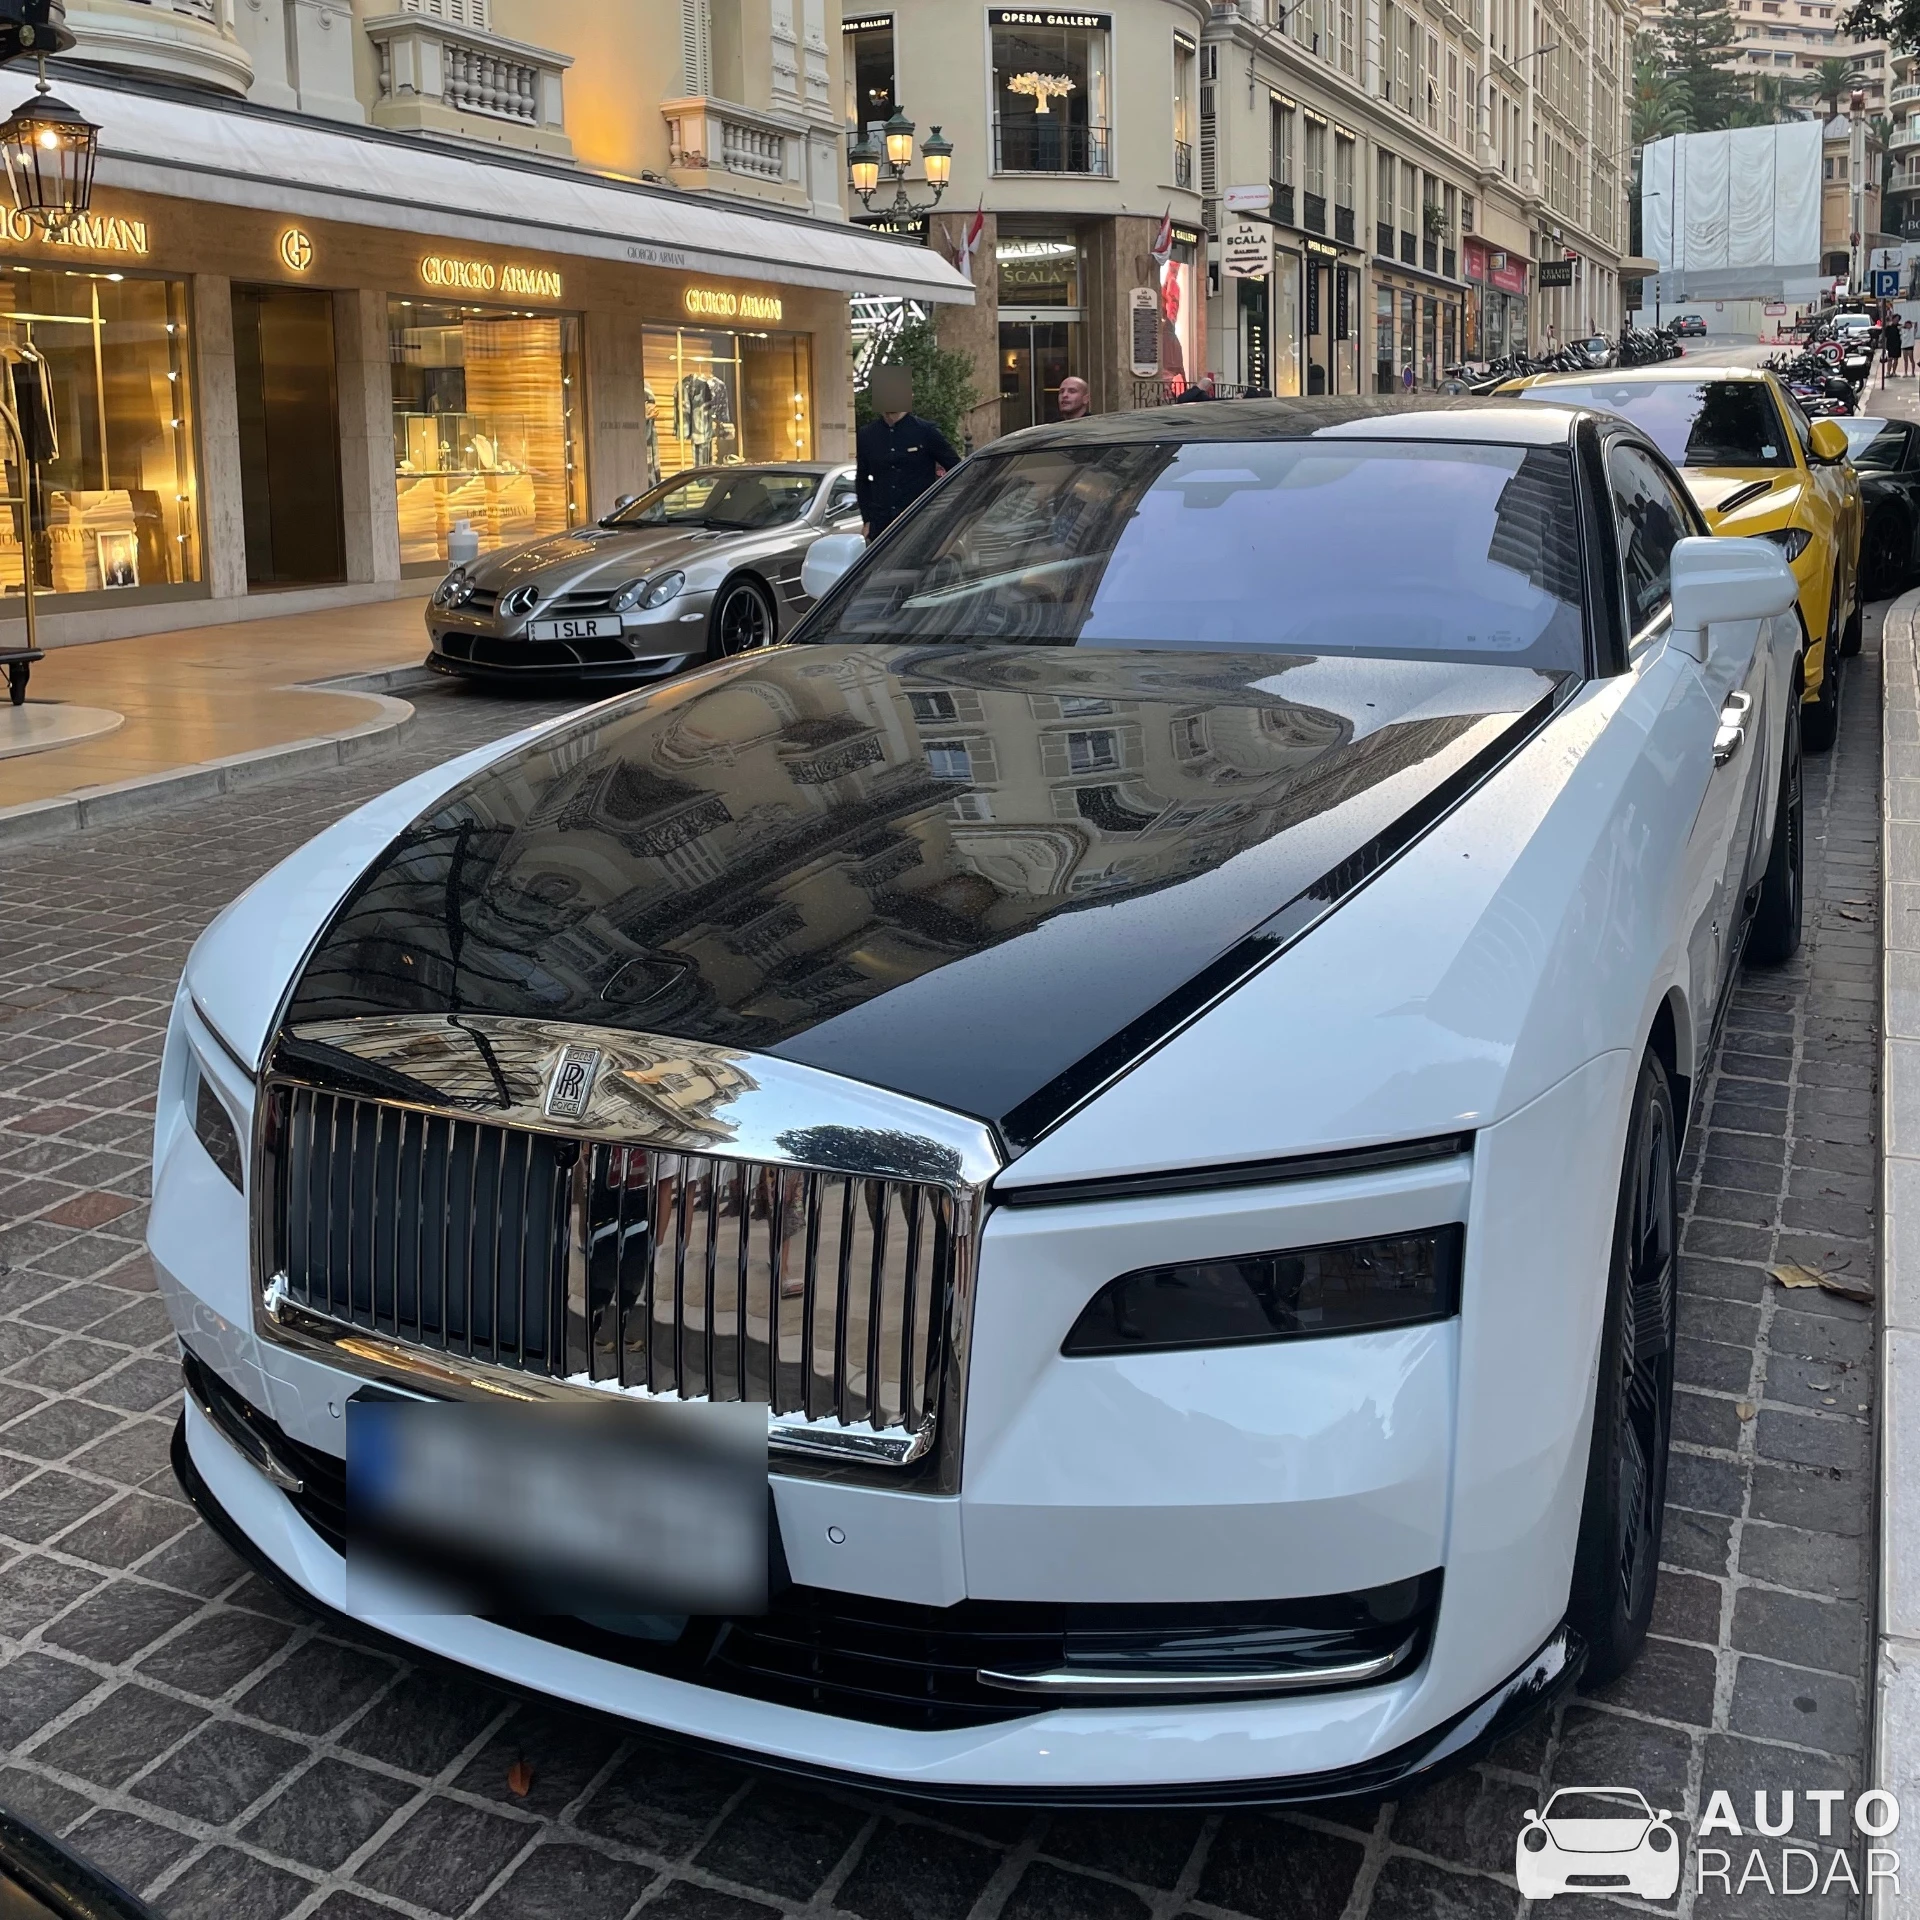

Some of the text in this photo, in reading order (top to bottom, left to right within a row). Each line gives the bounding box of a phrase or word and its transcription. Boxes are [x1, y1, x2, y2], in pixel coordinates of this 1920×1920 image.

[1002, 12, 1099, 26] OPERA GALLERY
[869, 221, 922, 233] GALLRY
[1002, 242, 1060, 254] PALAIS
[1227, 235, 1267, 245] SCALA
[627, 246, 685, 265] GIORGIO ARMANI
[421, 256, 561, 298] GIORGIO ARMANI
[1004, 270, 1061, 283] SCALA
[1882, 275, 1894, 293] P
[685, 289, 782, 320] GIORGIO ARMANI
[563, 620, 597, 638] SLR
[558, 1062, 584, 1099] RR
[552, 1101, 578, 1112] ROYCE
